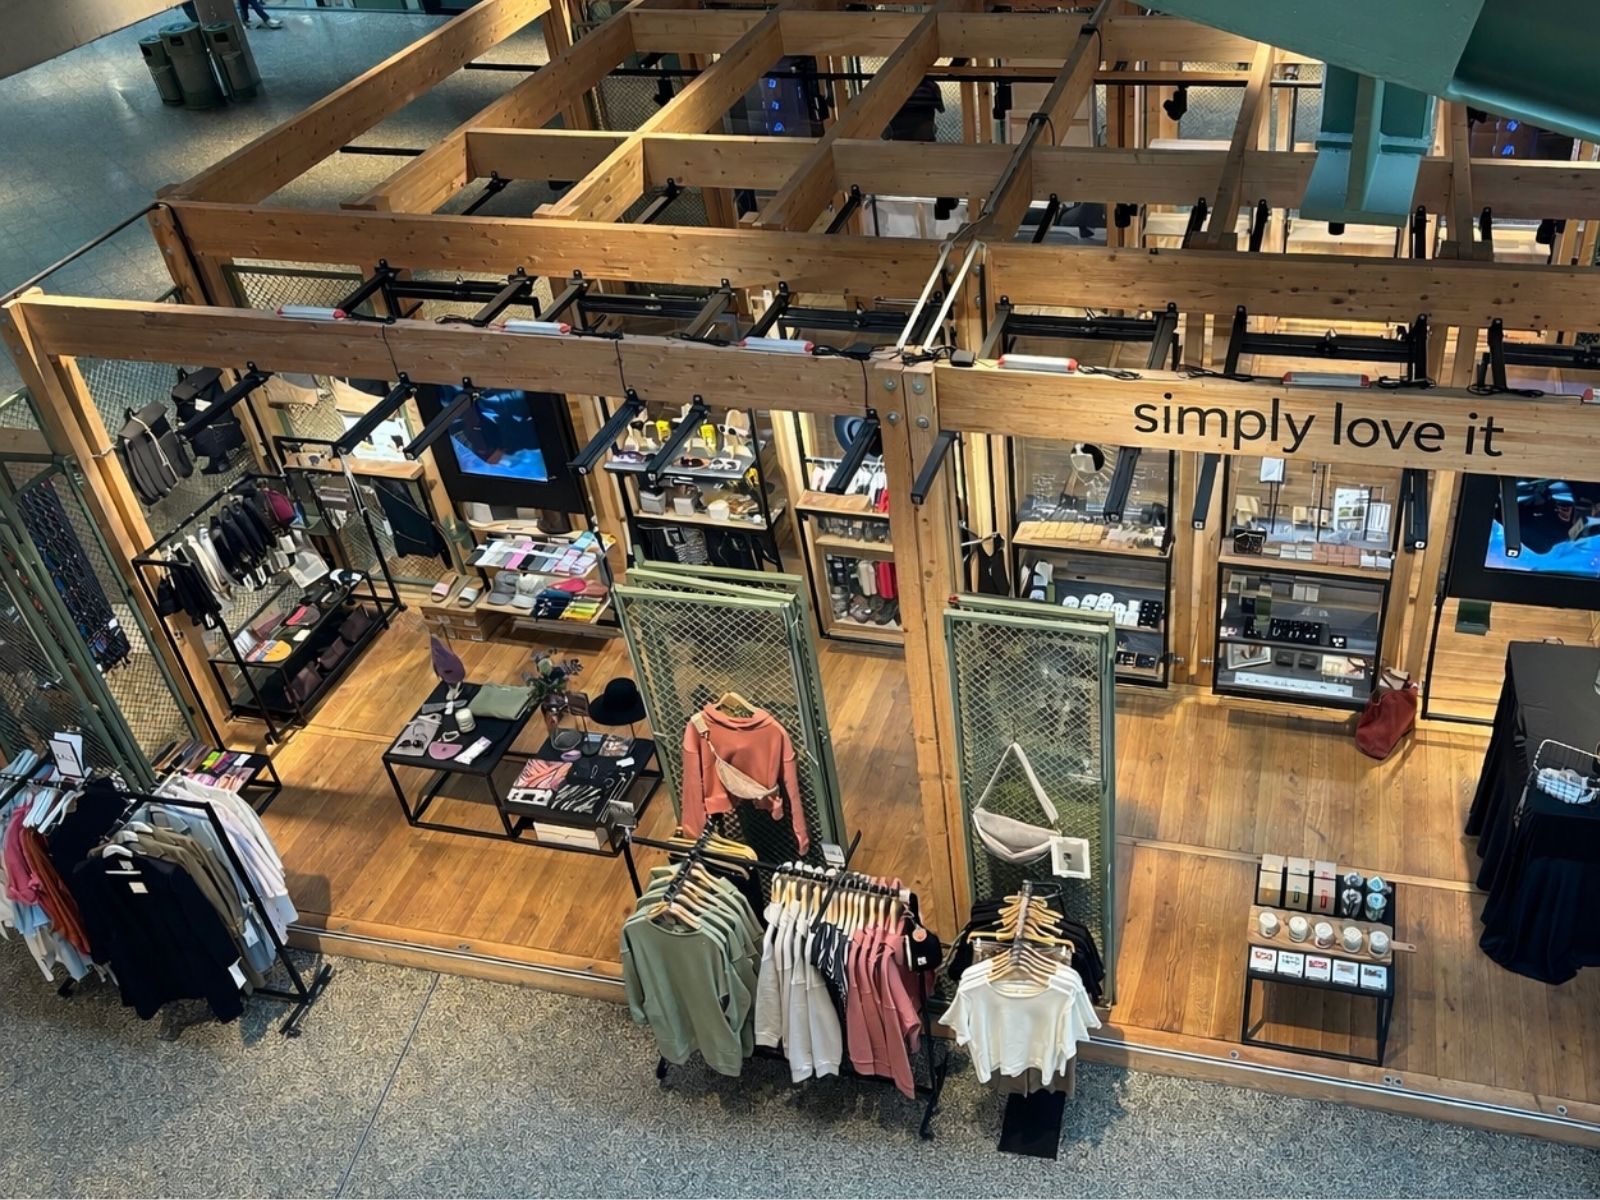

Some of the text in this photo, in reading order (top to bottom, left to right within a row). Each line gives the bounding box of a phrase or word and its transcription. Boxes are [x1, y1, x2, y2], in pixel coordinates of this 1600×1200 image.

[1134, 393, 1505, 458] simply love it
